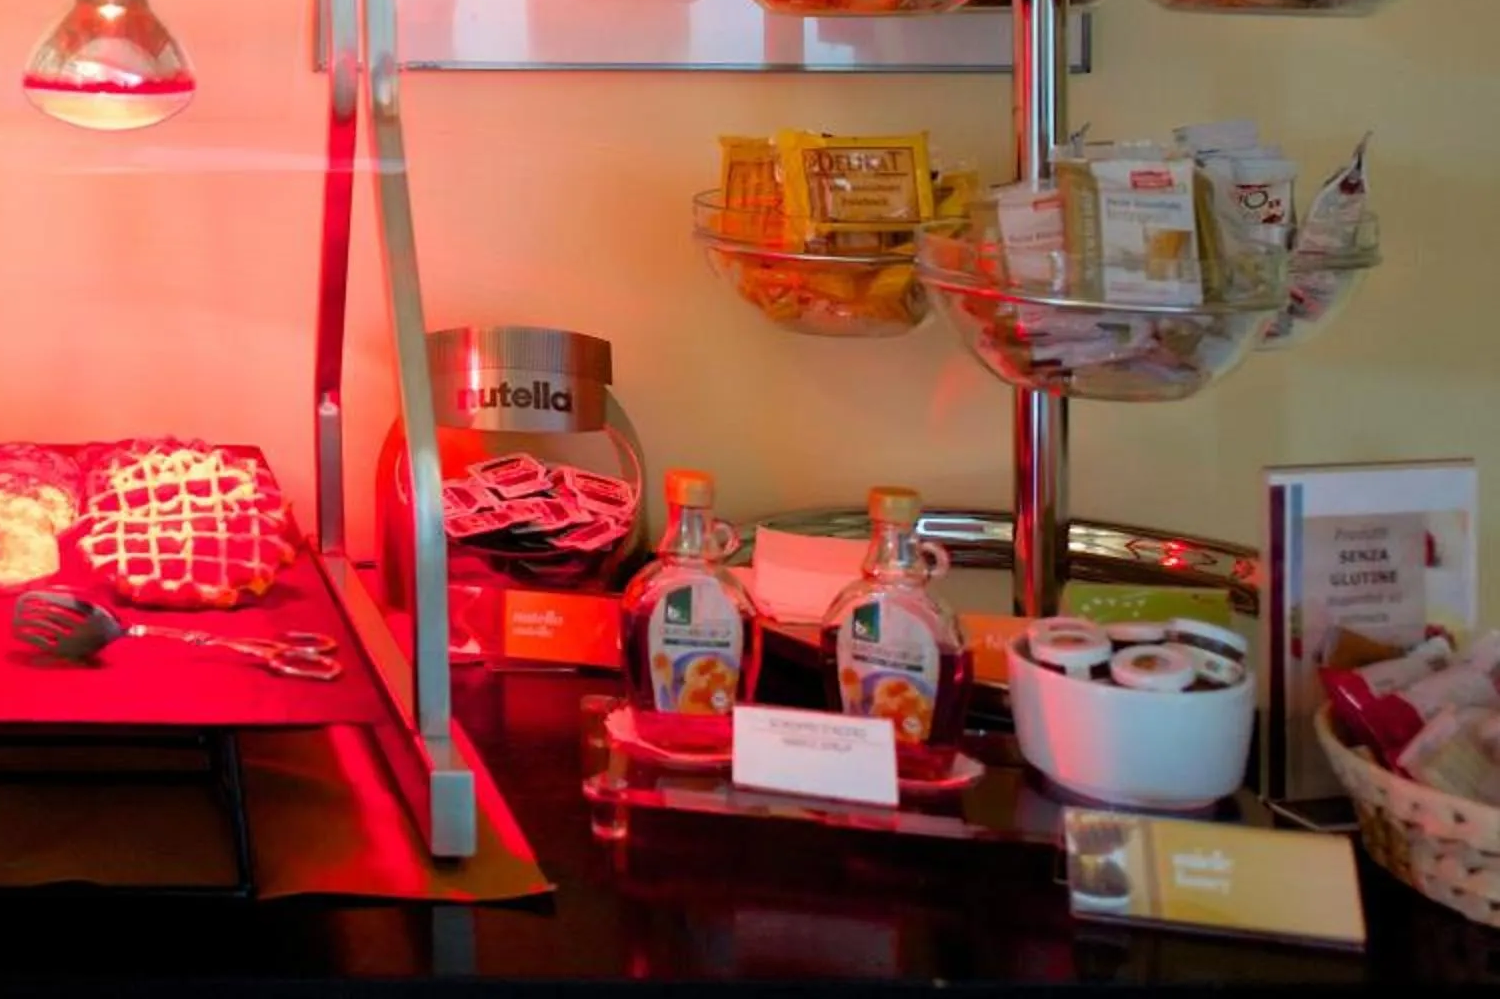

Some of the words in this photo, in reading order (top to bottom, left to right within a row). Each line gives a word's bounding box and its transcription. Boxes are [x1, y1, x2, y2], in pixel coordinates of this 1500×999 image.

[457, 381, 573, 413] nutella
[1339, 548, 1390, 565] SENZA
[1329, 569, 1398, 587] GLUTINE
